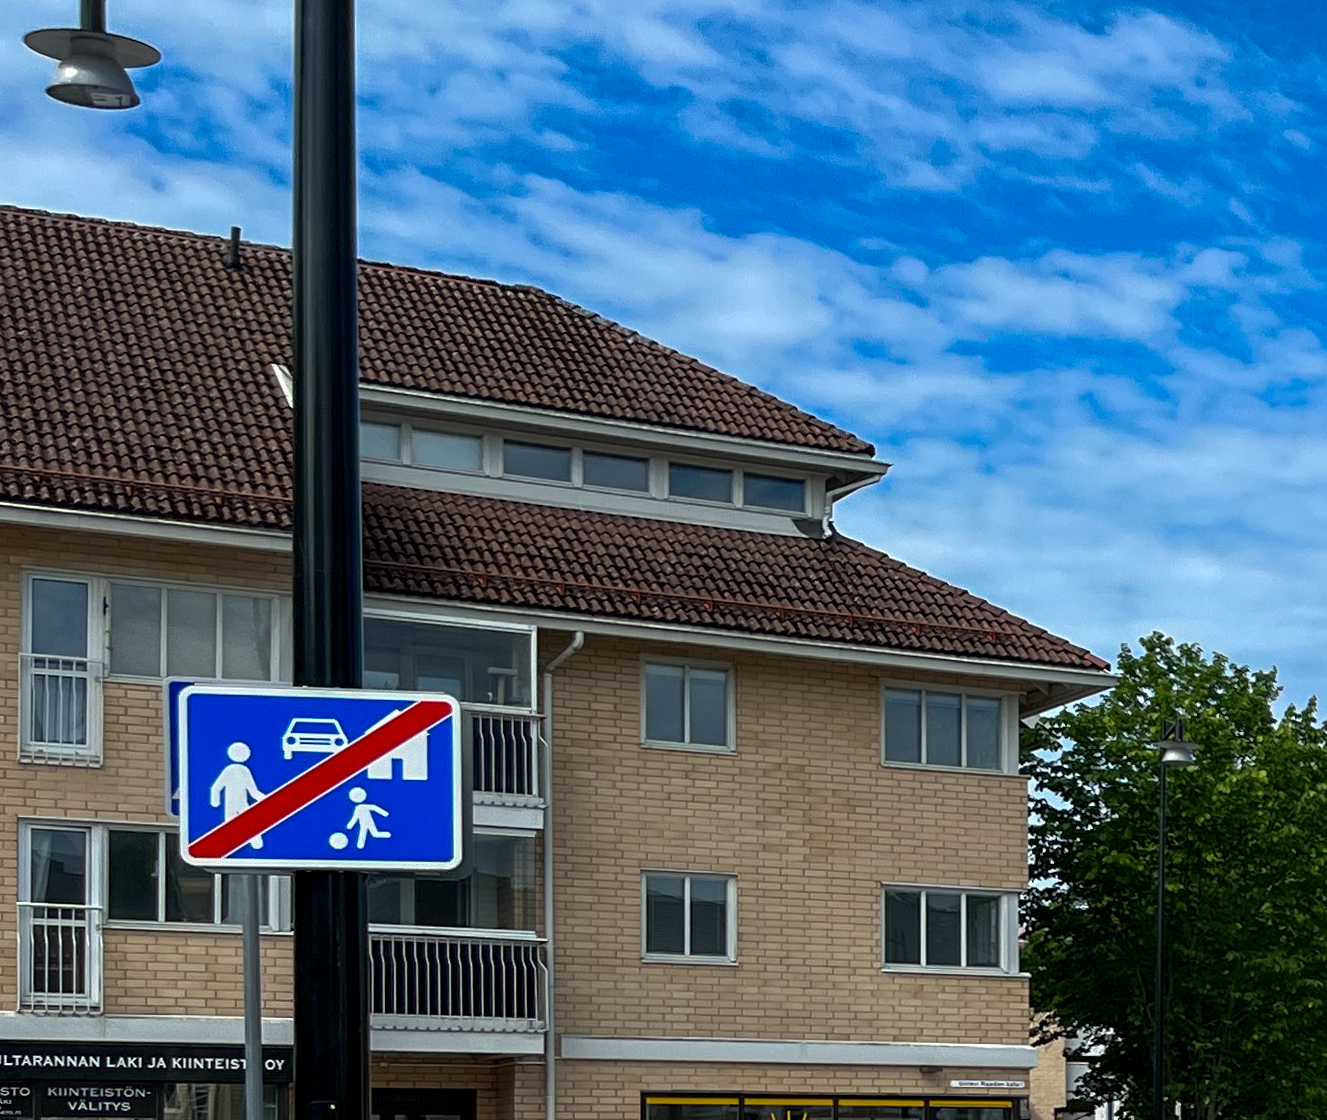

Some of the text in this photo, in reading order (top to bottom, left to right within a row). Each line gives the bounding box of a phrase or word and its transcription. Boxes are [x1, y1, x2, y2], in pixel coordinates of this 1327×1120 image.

[0, 1054, 285, 1071] LTARANNAN LAKI JA KIINTEIST OY
[47, 1085, 152, 1098] KIINTEISTÖN-
[67, 1099, 131, 1112] VÄLITYS
